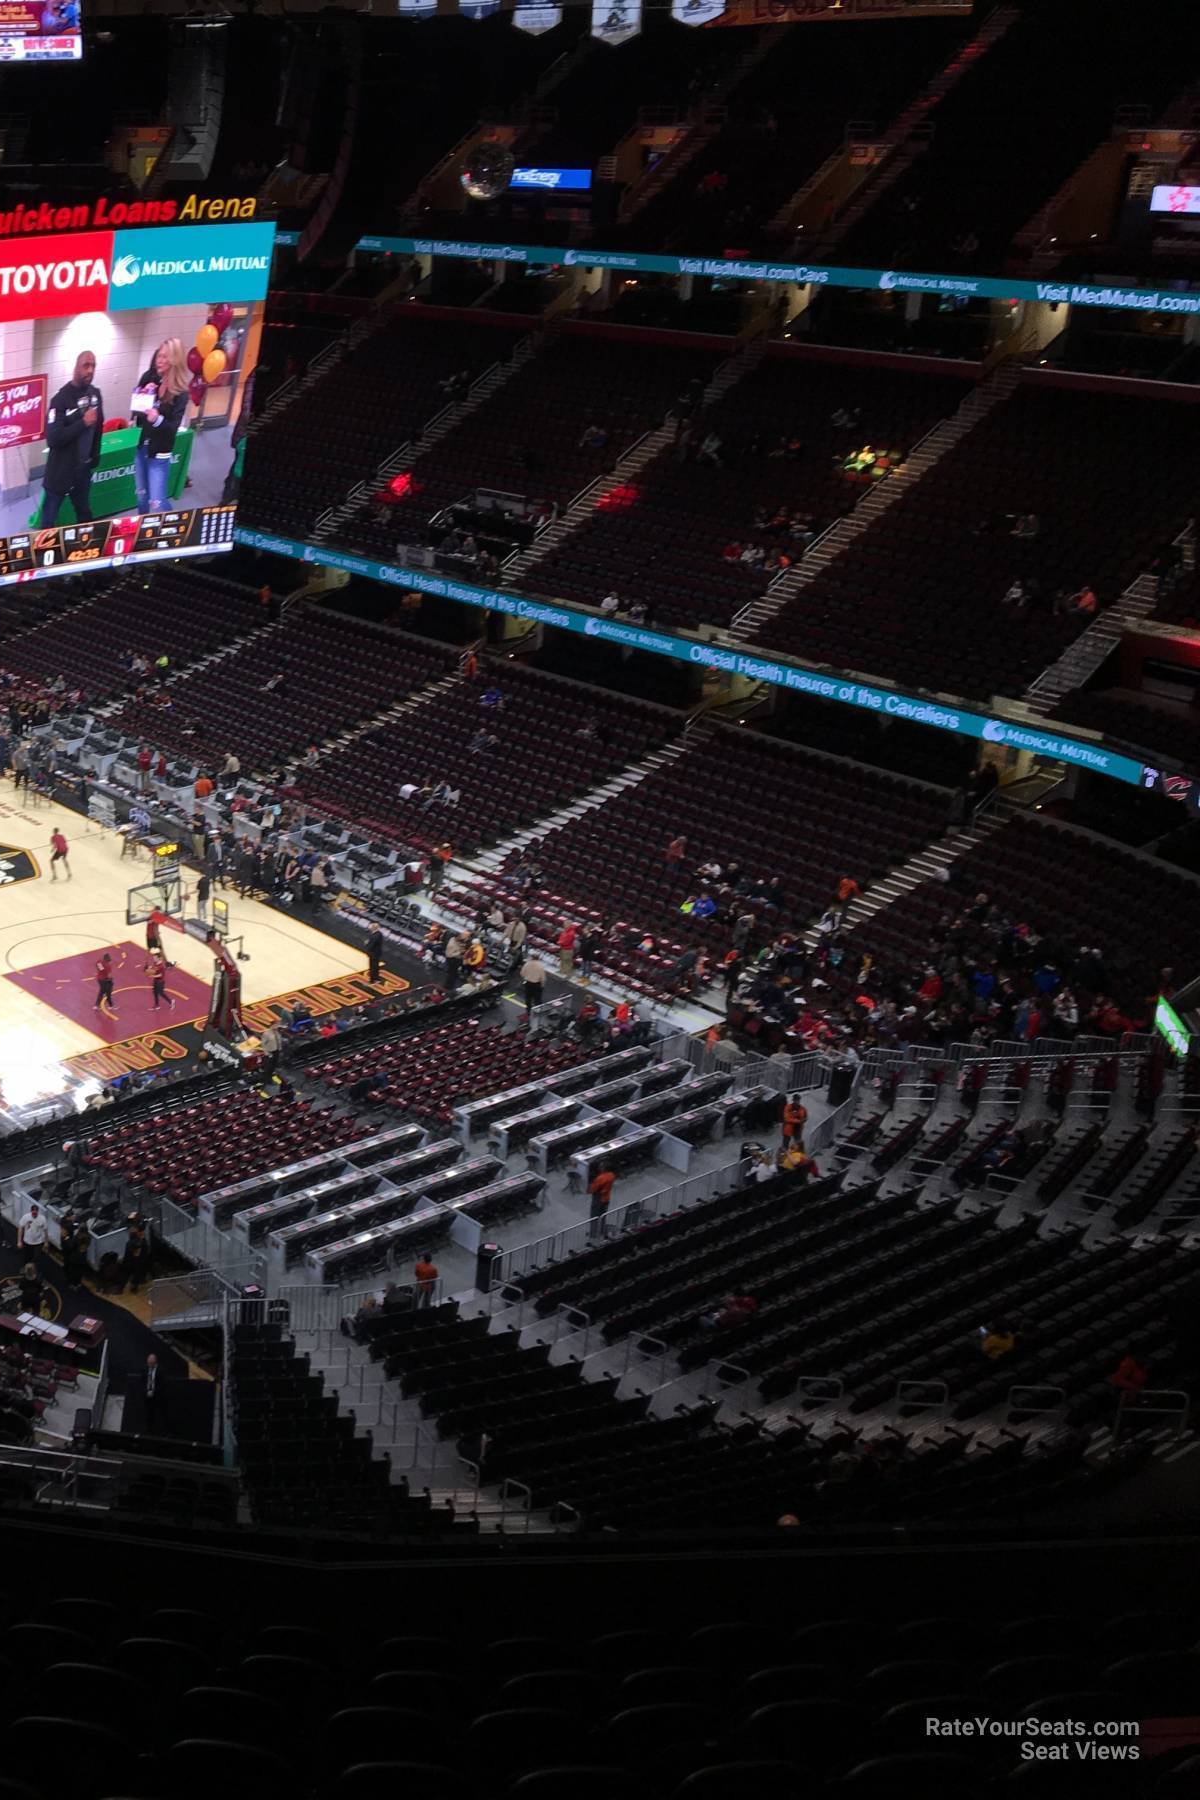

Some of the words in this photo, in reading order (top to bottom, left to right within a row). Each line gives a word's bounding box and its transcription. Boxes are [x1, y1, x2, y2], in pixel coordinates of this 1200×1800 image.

[92, 198, 177, 226] Loans
[179, 194, 257, 220] Arena
[140, 260, 206, 276] MEDICAL
[209, 256, 267, 271] MUTUAL
[679, 258, 702, 274] Visit
[704, 260, 829, 283] MedMutual.com/Cavs
[899, 277, 938, 289] MEDICAL
[939, 280, 978, 292] MUTUAL
[1037, 284, 1068, 302] Visit
[6, 384, 29, 402] YOU
[1, 405, 11, 419] A
[12, 396, 42, 416] PRO?
[67, 548, 100, 561] 42:35
[114, 539, 124, 553] 0
[254, 534, 293, 555] Cavaliers
[43, 550, 55, 566] 0
[380, 566, 412, 585] Official
[414, 575, 446, 594] Health
[448, 584, 484, 604] Insurer
[485, 594, 497, 607] of
[498, 597, 515, 612] the
[517, 601, 569, 626] Cavaliers
[601, 624, 637, 641] MEDICAL
[639, 634, 674, 651] MUTUAL
[690, 645, 735, 671] Official
[738, 657, 783, 682] Health
[786, 670, 837, 696] Insurer
[839, 685, 856, 700] of
[857, 689, 881, 708] the
[885, 696, 960, 729] Cavaliers
[1005, 729, 1058, 752] MEDICAL
[1061, 743, 1110, 767] MUTUAL
